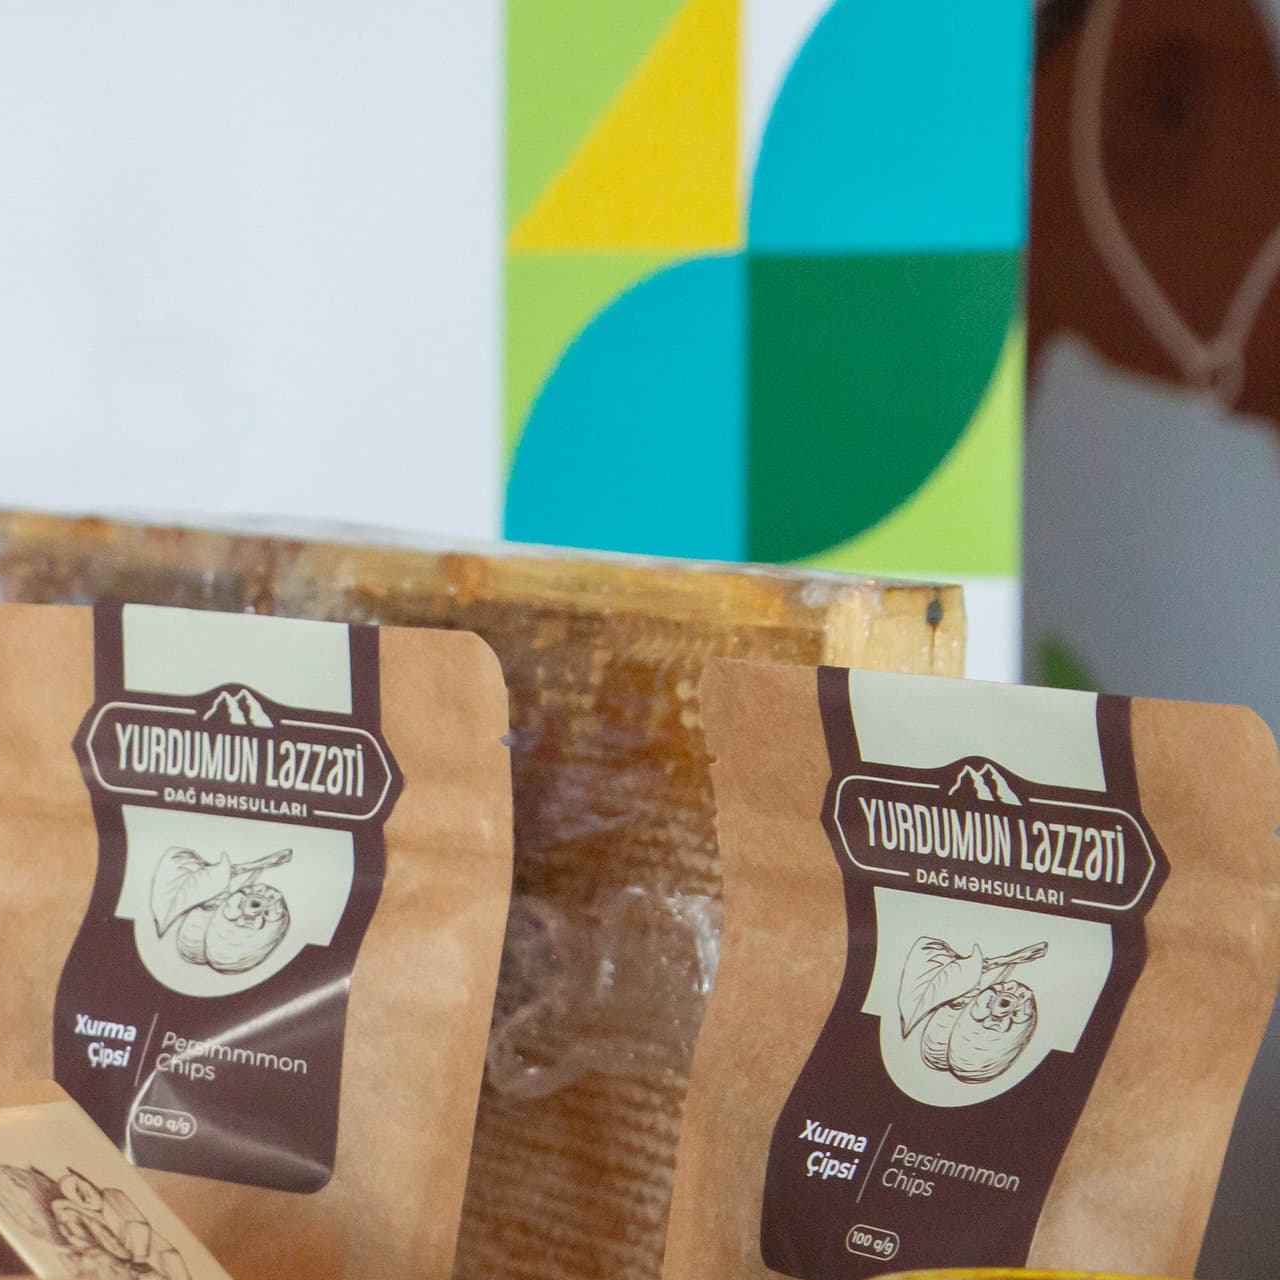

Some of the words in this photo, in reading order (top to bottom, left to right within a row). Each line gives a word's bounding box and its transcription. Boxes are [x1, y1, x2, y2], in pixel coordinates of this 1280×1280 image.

[115, 721, 258, 785] YURDUMUN
[163, 787, 197, 805] DAĞ
[201, 791, 308, 818] MƏHSULLARI
[858, 797, 1010, 866] YURDUMUN
[916, 867, 949, 889] DAĞ
[954, 874, 1065, 906] MƏHSULLARI
[74, 1014, 137, 1042] Xurma
[88, 1041, 131, 1068] Çipsi
[155, 1053, 216, 1081] Chips
[139, 1111, 163, 1127] 100
[799, 1119, 867, 1153] Xurma
[806, 1150, 859, 1181] Çipsi
[882, 1168, 936, 1198] Chips
[851, 1231, 872, 1246] 100
[874, 1237, 894, 1255] q/g
